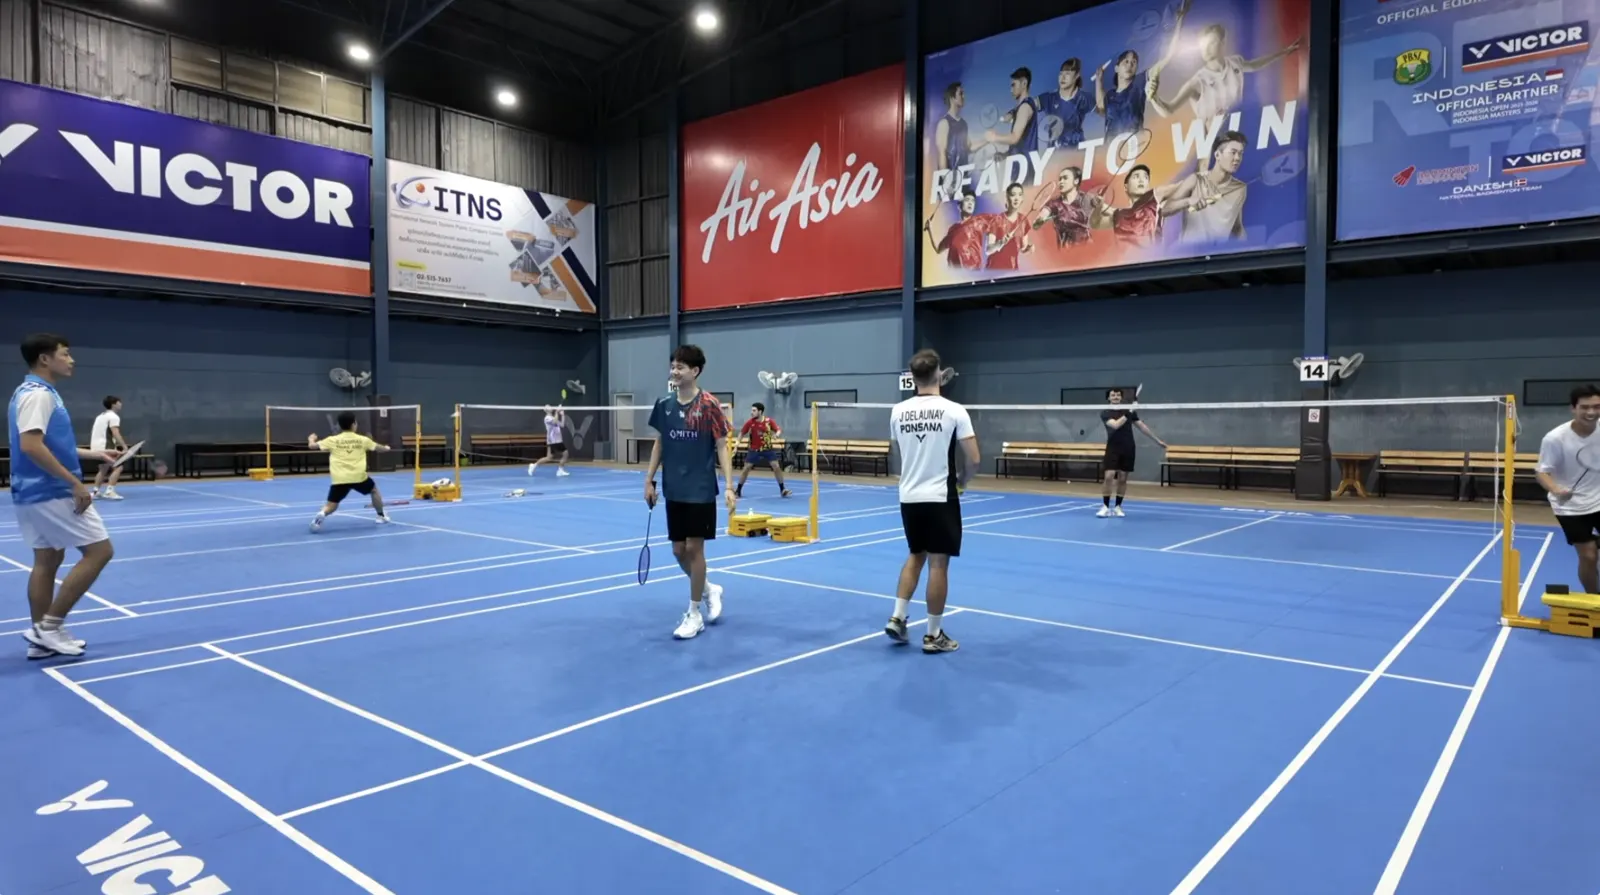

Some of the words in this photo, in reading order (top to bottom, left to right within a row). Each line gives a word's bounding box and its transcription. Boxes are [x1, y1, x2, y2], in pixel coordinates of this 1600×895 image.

[1377, 4, 1438, 25] OFFICIAL
[1496, 26, 1583, 53] VICTOR
[1412, 73, 1543, 104] INDONESIA
[1436, 95, 1493, 113] OFFICIAL
[1496, 84, 1559, 103] PARTNER
[1452, 107, 1489, 118] INDONESIA
[1490, 104, 1509, 112] OPEN
[1452, 114, 1489, 125] INDONESIA
[1490, 109, 1521, 119] MASTERS
[1524, 148, 1582, 164] VICTOR
[930, 147, 1056, 205] READY
[1078, 131, 1138, 180] TO
[58, 130, 354, 228] VICTOR
[1453, 181, 1513, 194] DANISH
[434, 186, 503, 221] ITNS
[1304, 364, 1325, 379] 14
[901, 378, 913, 389] 15
[905, 409, 945, 421] DELAUNAY
[900, 422, 943, 434] PONSANA
